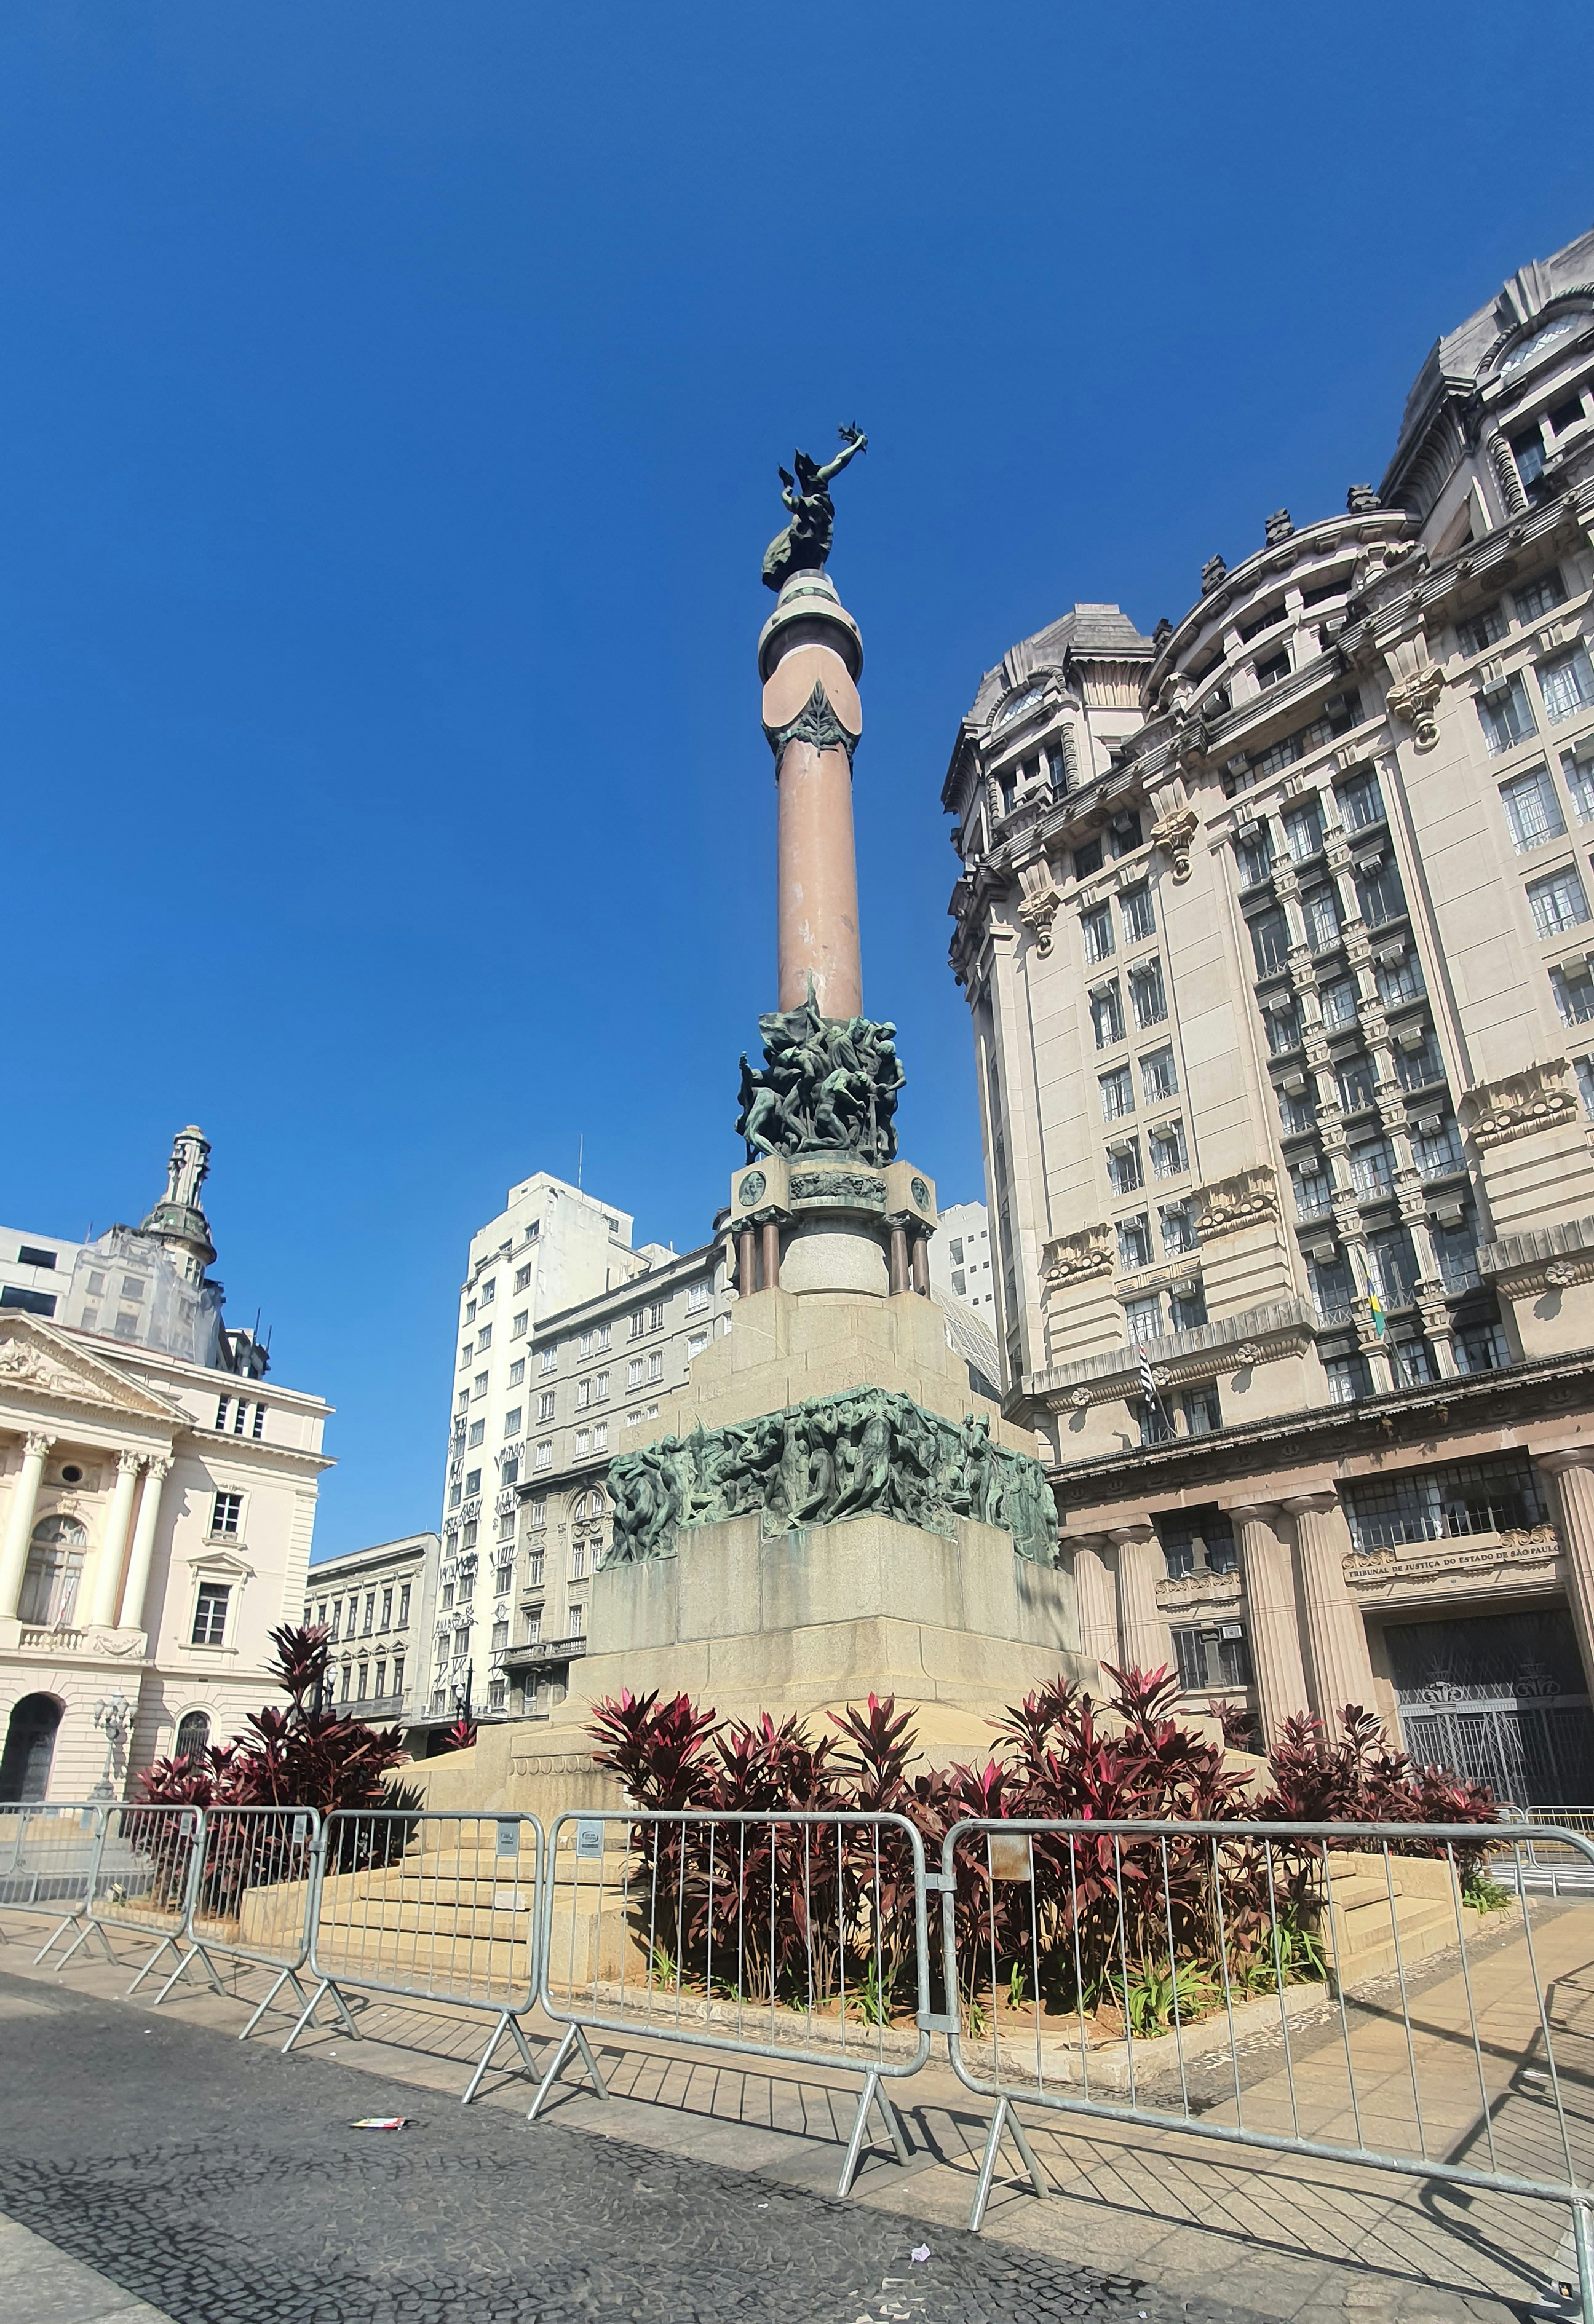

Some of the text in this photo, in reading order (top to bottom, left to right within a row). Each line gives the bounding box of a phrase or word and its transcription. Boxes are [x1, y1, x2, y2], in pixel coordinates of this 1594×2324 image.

[1349, 1567, 1389, 1578] TRIBUNAL
[1405, 1560, 1440, 1571] JUSTIÇA
[1459, 1554, 1494, 1563] ESTADO
[1510, 1548, 1530, 1557] SÃO
[1531, 1545, 1560, 1554] PAULO
